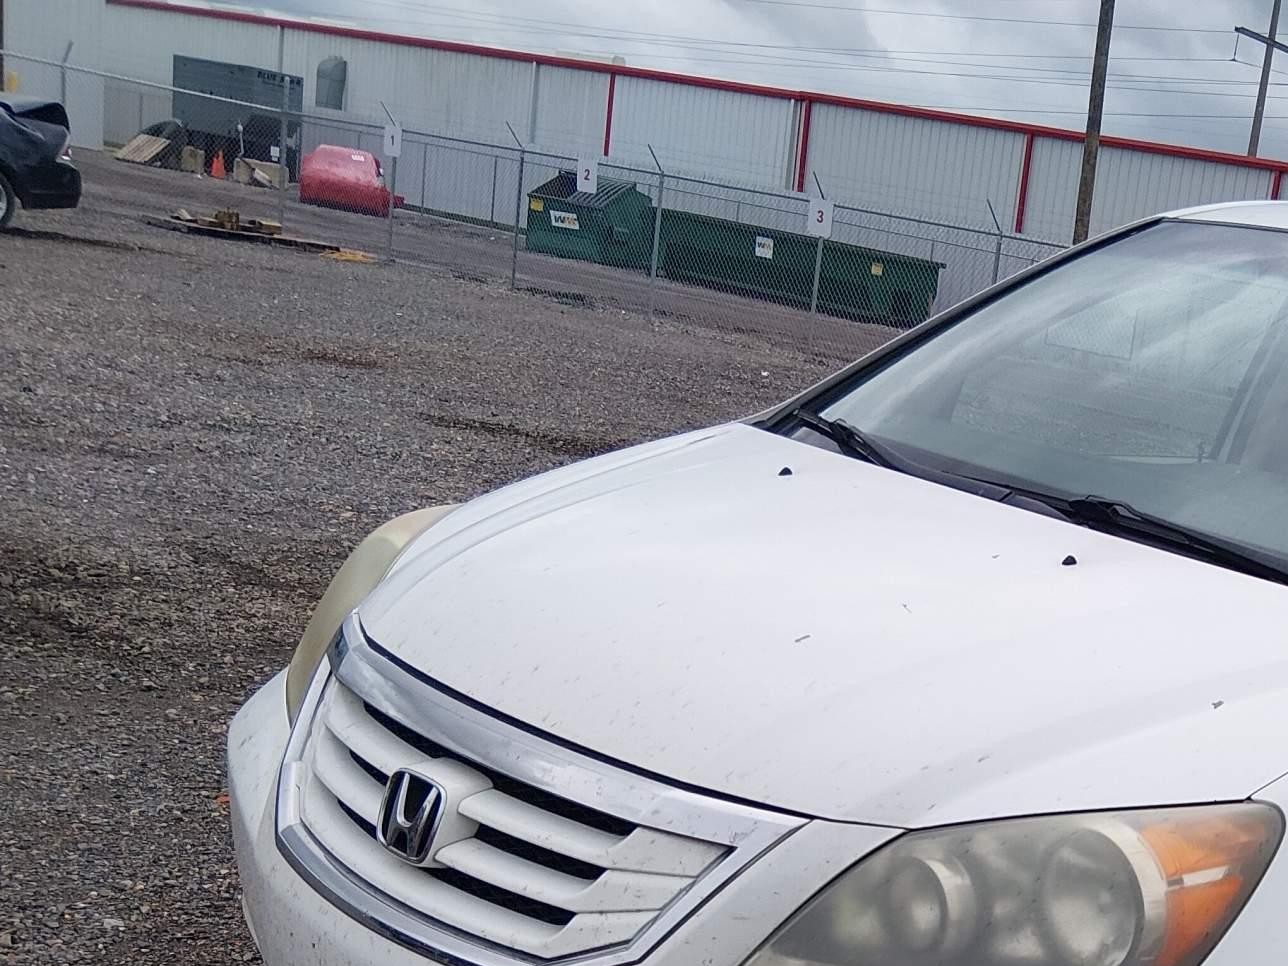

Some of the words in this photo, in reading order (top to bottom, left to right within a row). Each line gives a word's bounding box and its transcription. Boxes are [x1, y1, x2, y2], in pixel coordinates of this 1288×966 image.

[390, 135, 395, 146] 1
[584, 169, 591, 181] 2
[816, 209, 825, 223] 3
